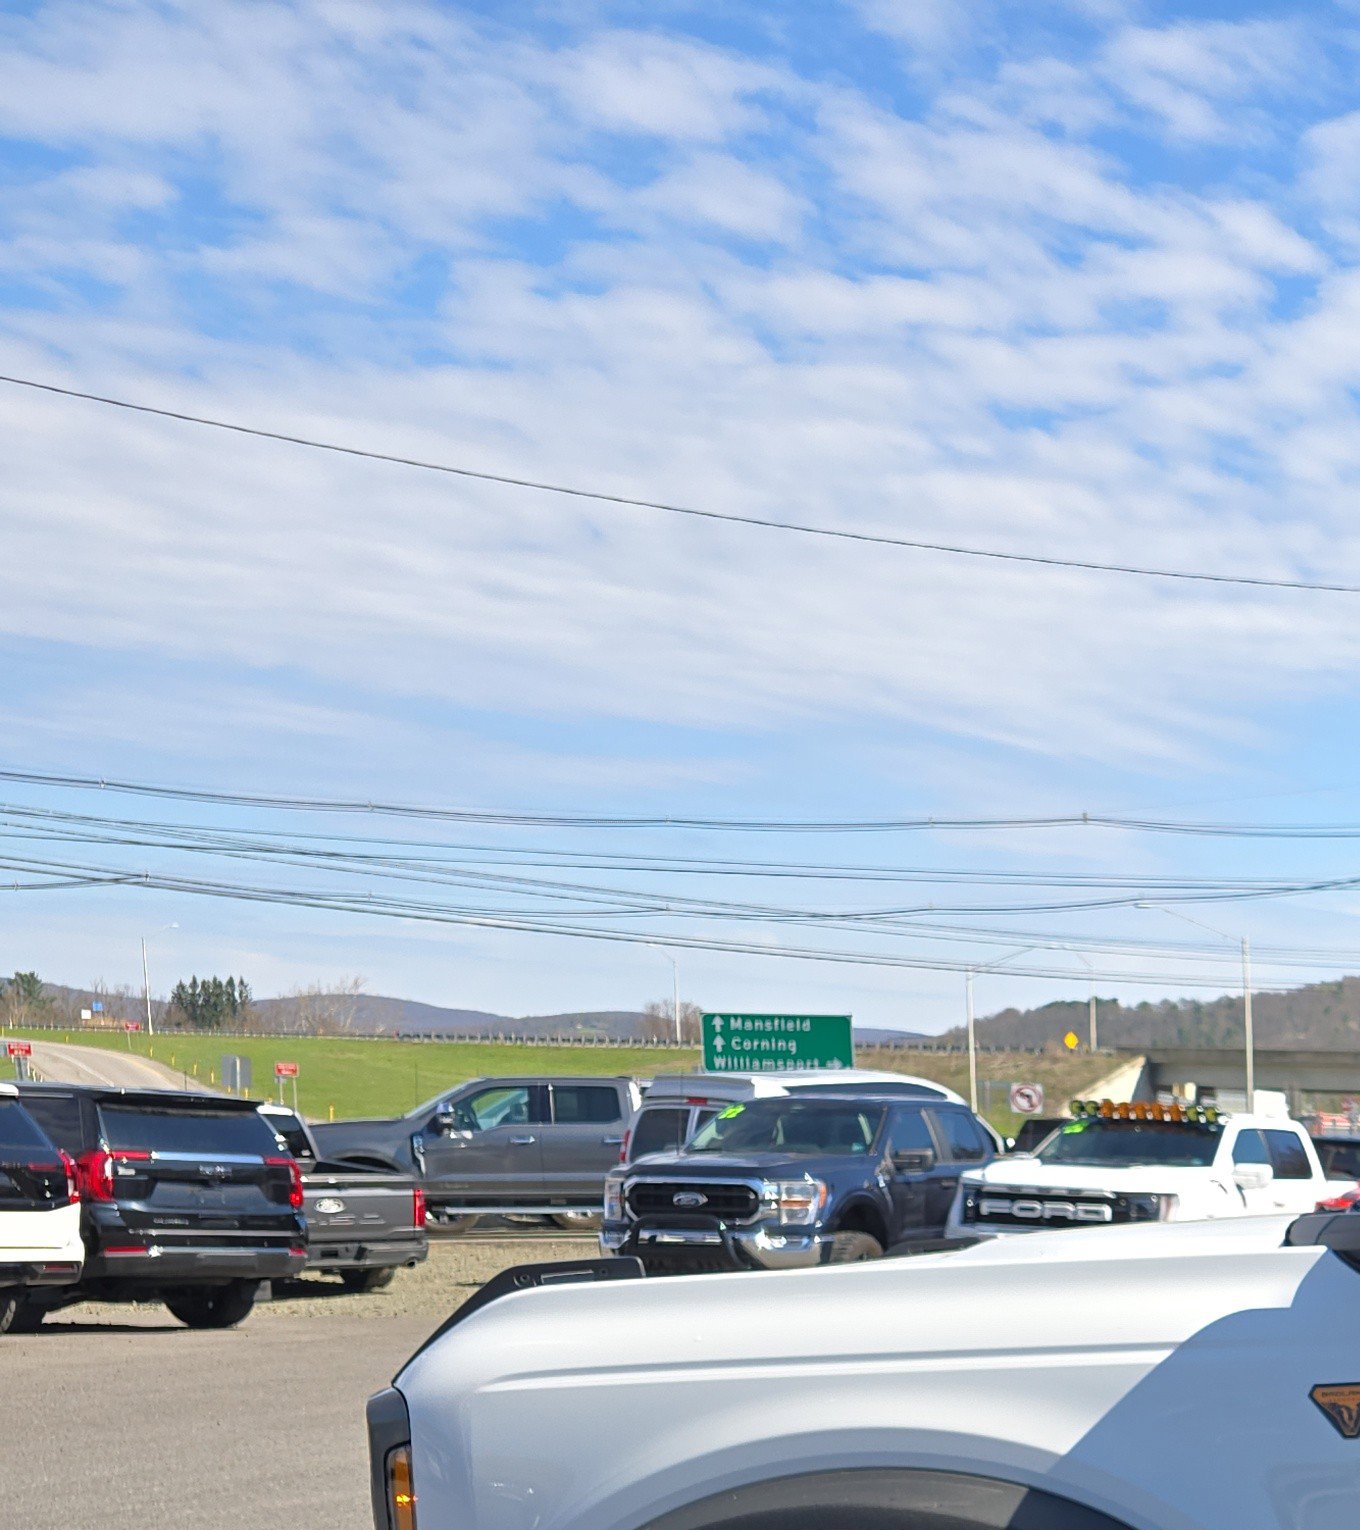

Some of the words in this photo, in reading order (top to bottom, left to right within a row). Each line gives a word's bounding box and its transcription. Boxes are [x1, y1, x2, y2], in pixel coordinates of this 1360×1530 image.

[730, 1017, 811, 1032] Mansfield
[731, 1036, 797, 1055] Corning
[713, 1055, 819, 1071] Williamsport
[980, 1198, 1112, 1222] FORD
